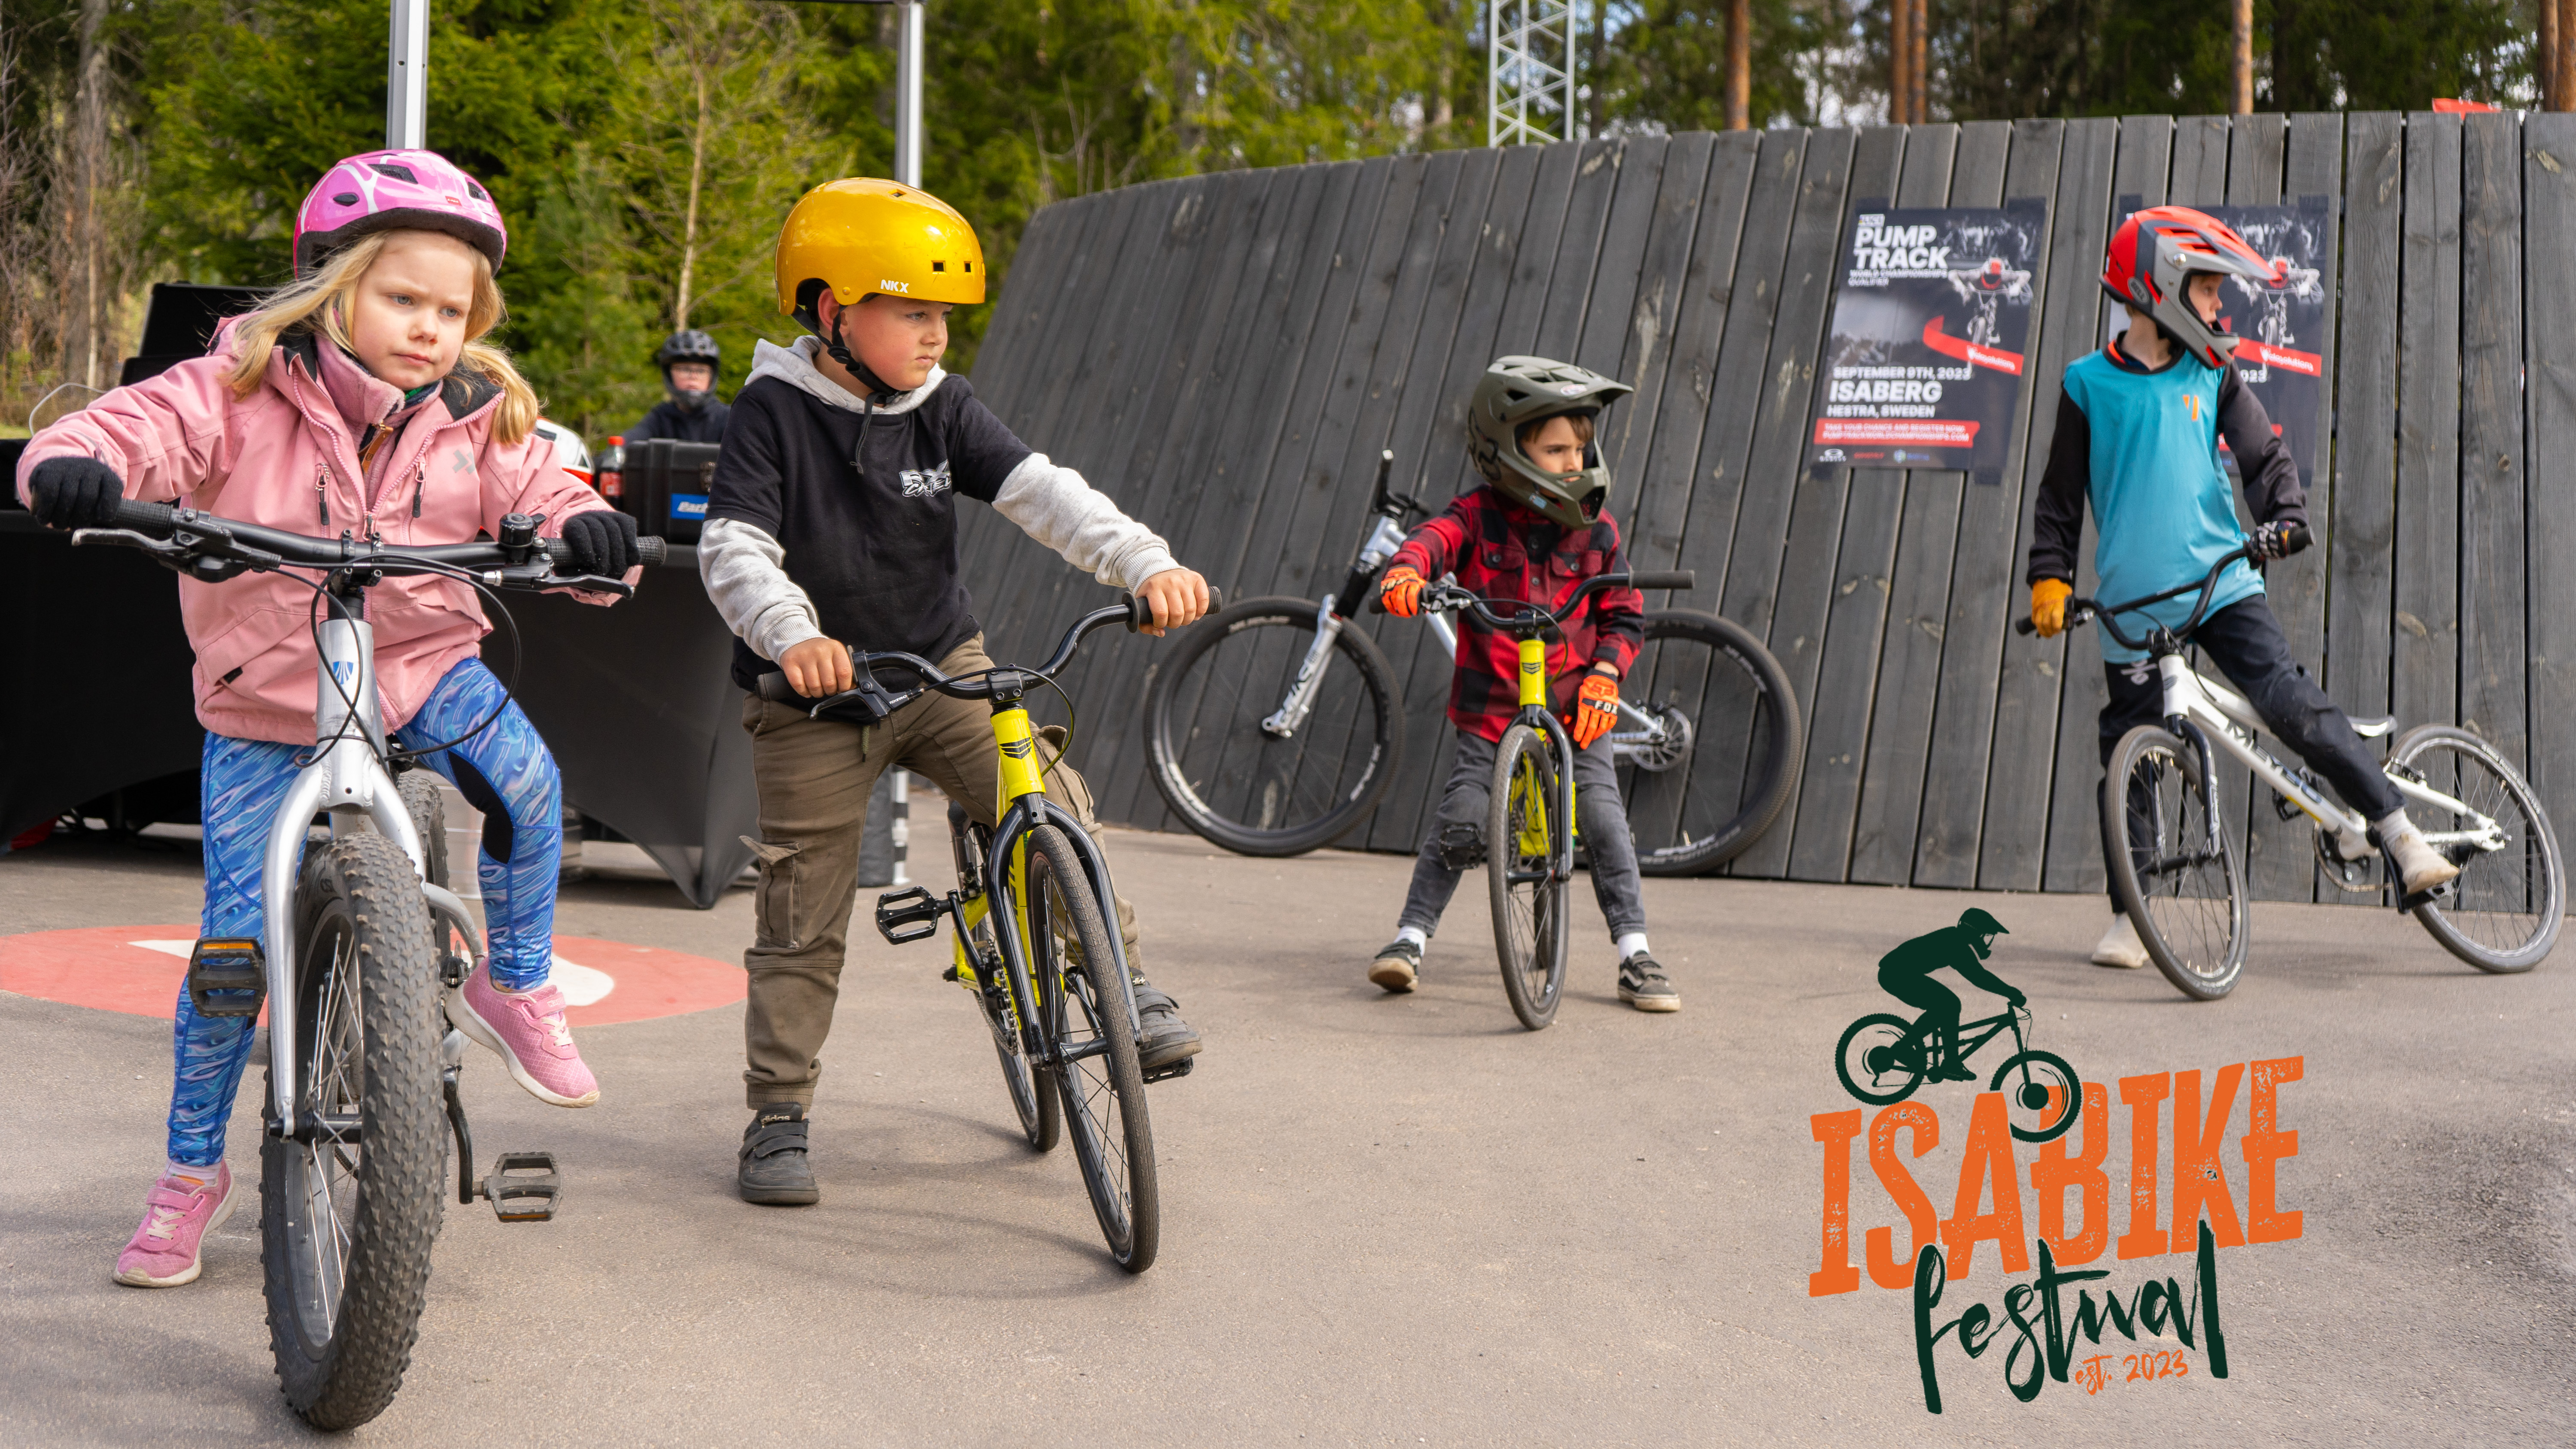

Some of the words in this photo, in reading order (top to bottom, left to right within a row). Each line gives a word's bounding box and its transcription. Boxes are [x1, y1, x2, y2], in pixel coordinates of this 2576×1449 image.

[1854, 225, 1937, 248] PUMP
[1853, 246, 1950, 269] TRACK
[1850, 269, 1879, 277] WORLD
[1880, 268, 1948, 278] CHAMPIONSHIPS
[880, 279, 909, 293] NKX
[1848, 277, 1889, 287] QUALIFIER
[1833, 367, 1905, 379] SEPTEMBER
[1907, 367, 1935, 381] 9TH,
[1937, 367, 1972, 380] 2023
[2240, 369, 2268, 383] 023
[1829, 380, 1942, 403] ISABERG
[1826, 404, 1879, 419] HESTRA,
[1880, 405, 1935, 418] SWEDEN
[1894, 424, 1910, 432] AND
[1911, 424, 1944, 432] REGISTER
[889, 694, 908, 704] TEKTRO
[1595, 700, 1617, 715] FOX
